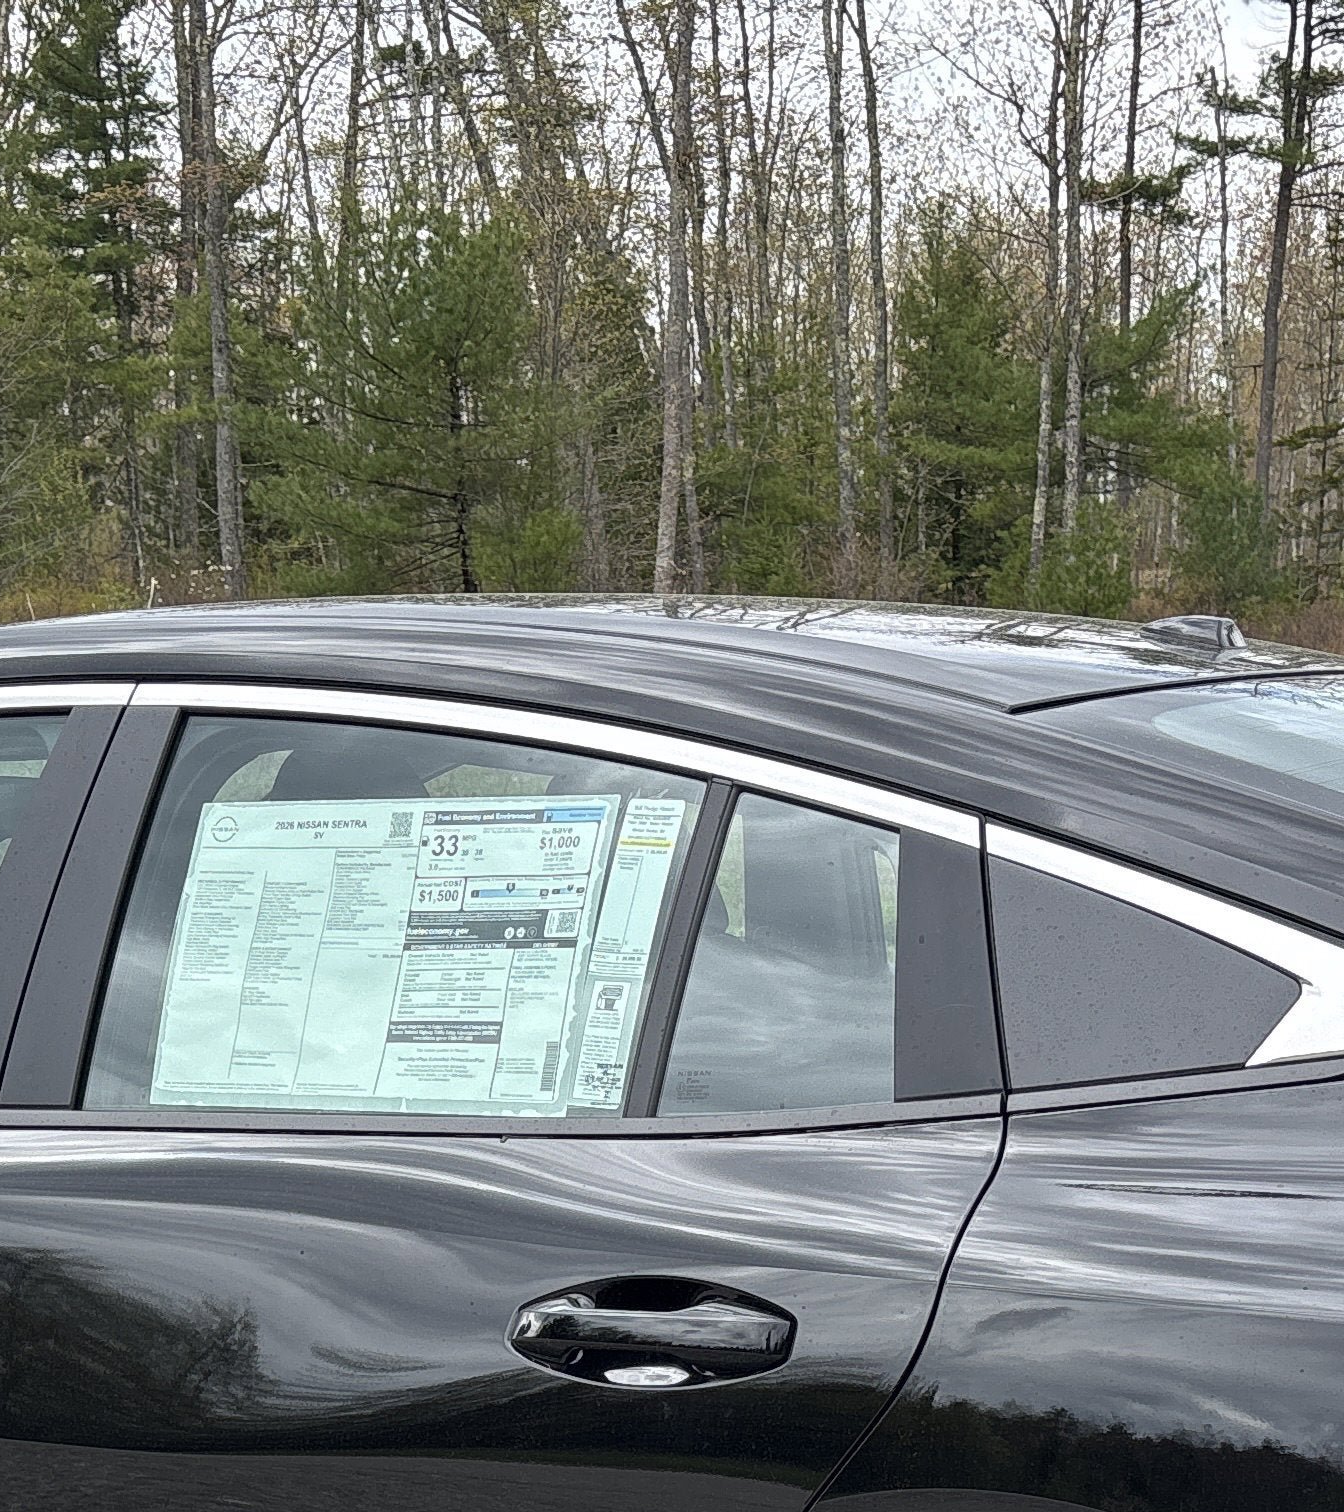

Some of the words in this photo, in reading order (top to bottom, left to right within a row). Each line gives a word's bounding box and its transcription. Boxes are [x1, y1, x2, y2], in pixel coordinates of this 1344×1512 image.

[275, 821, 295, 830] 2026
[296, 820, 329, 829] NISSAN
[331, 819, 367, 829] SENTRA
[313, 831, 325, 840] SV
[431, 834, 459, 857] 33
[539, 835, 581, 851] $1,000
[418, 889, 460, 904] $1,500
[677, 1070, 713, 1078] NISSAN
